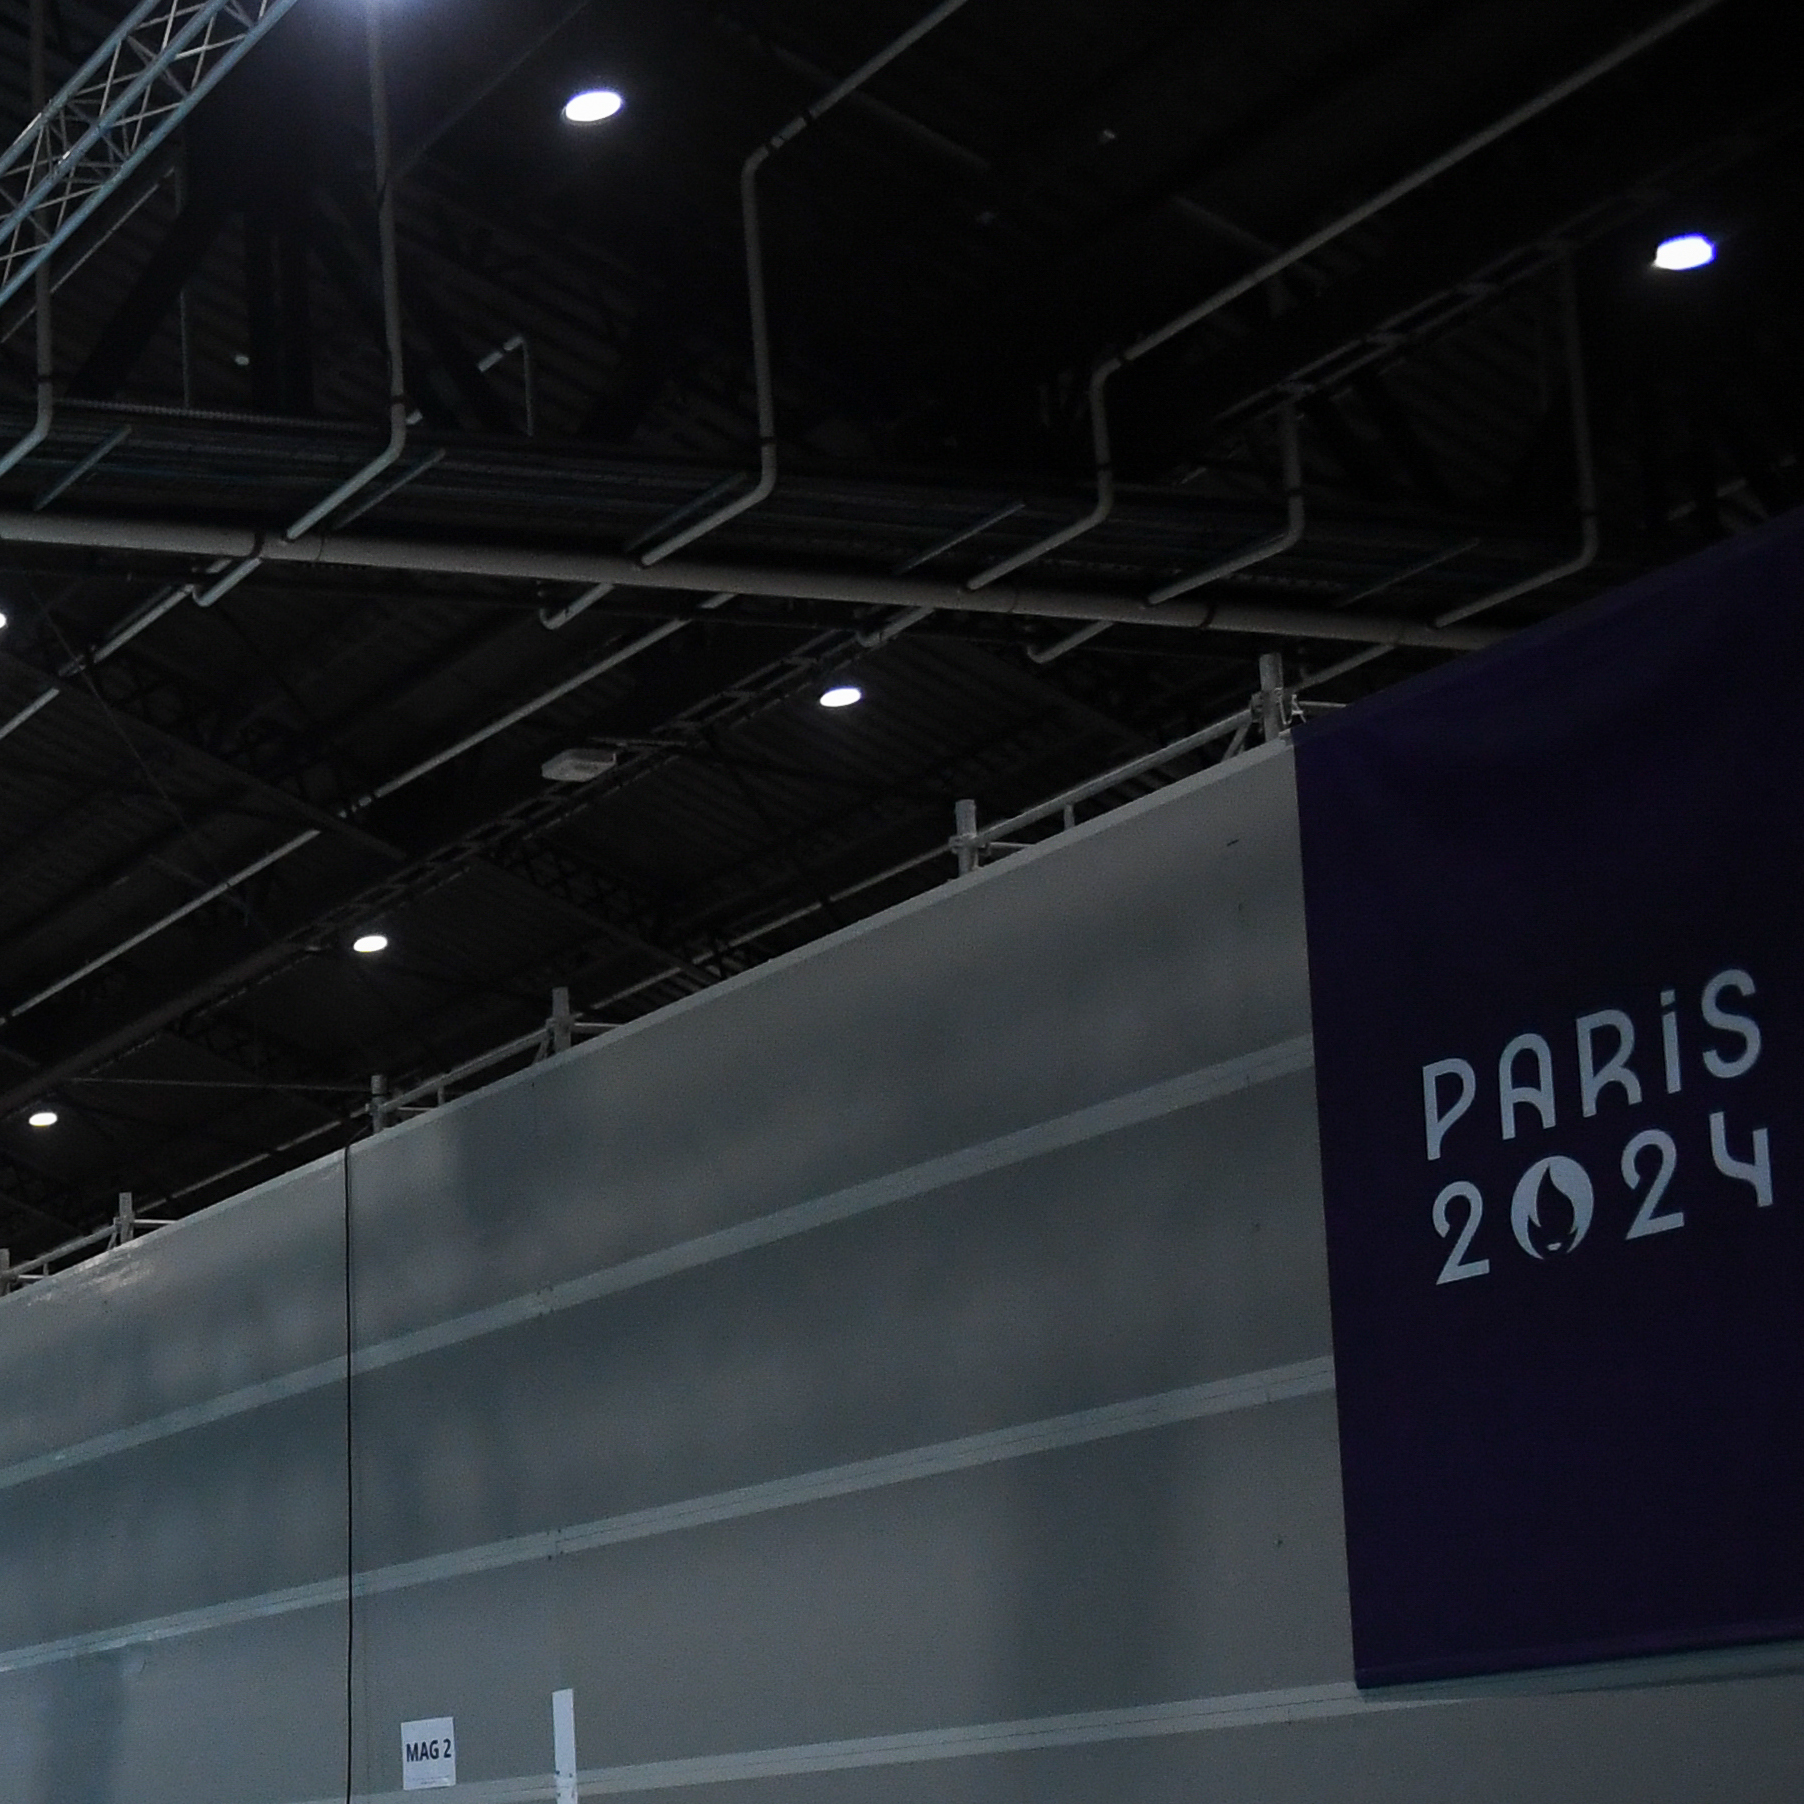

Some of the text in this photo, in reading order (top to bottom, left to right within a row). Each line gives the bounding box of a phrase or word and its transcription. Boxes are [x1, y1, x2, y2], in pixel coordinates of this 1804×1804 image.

[1432, 1111, 1774, 1286] 2024
[406, 1738, 452, 1763] MAG 2
